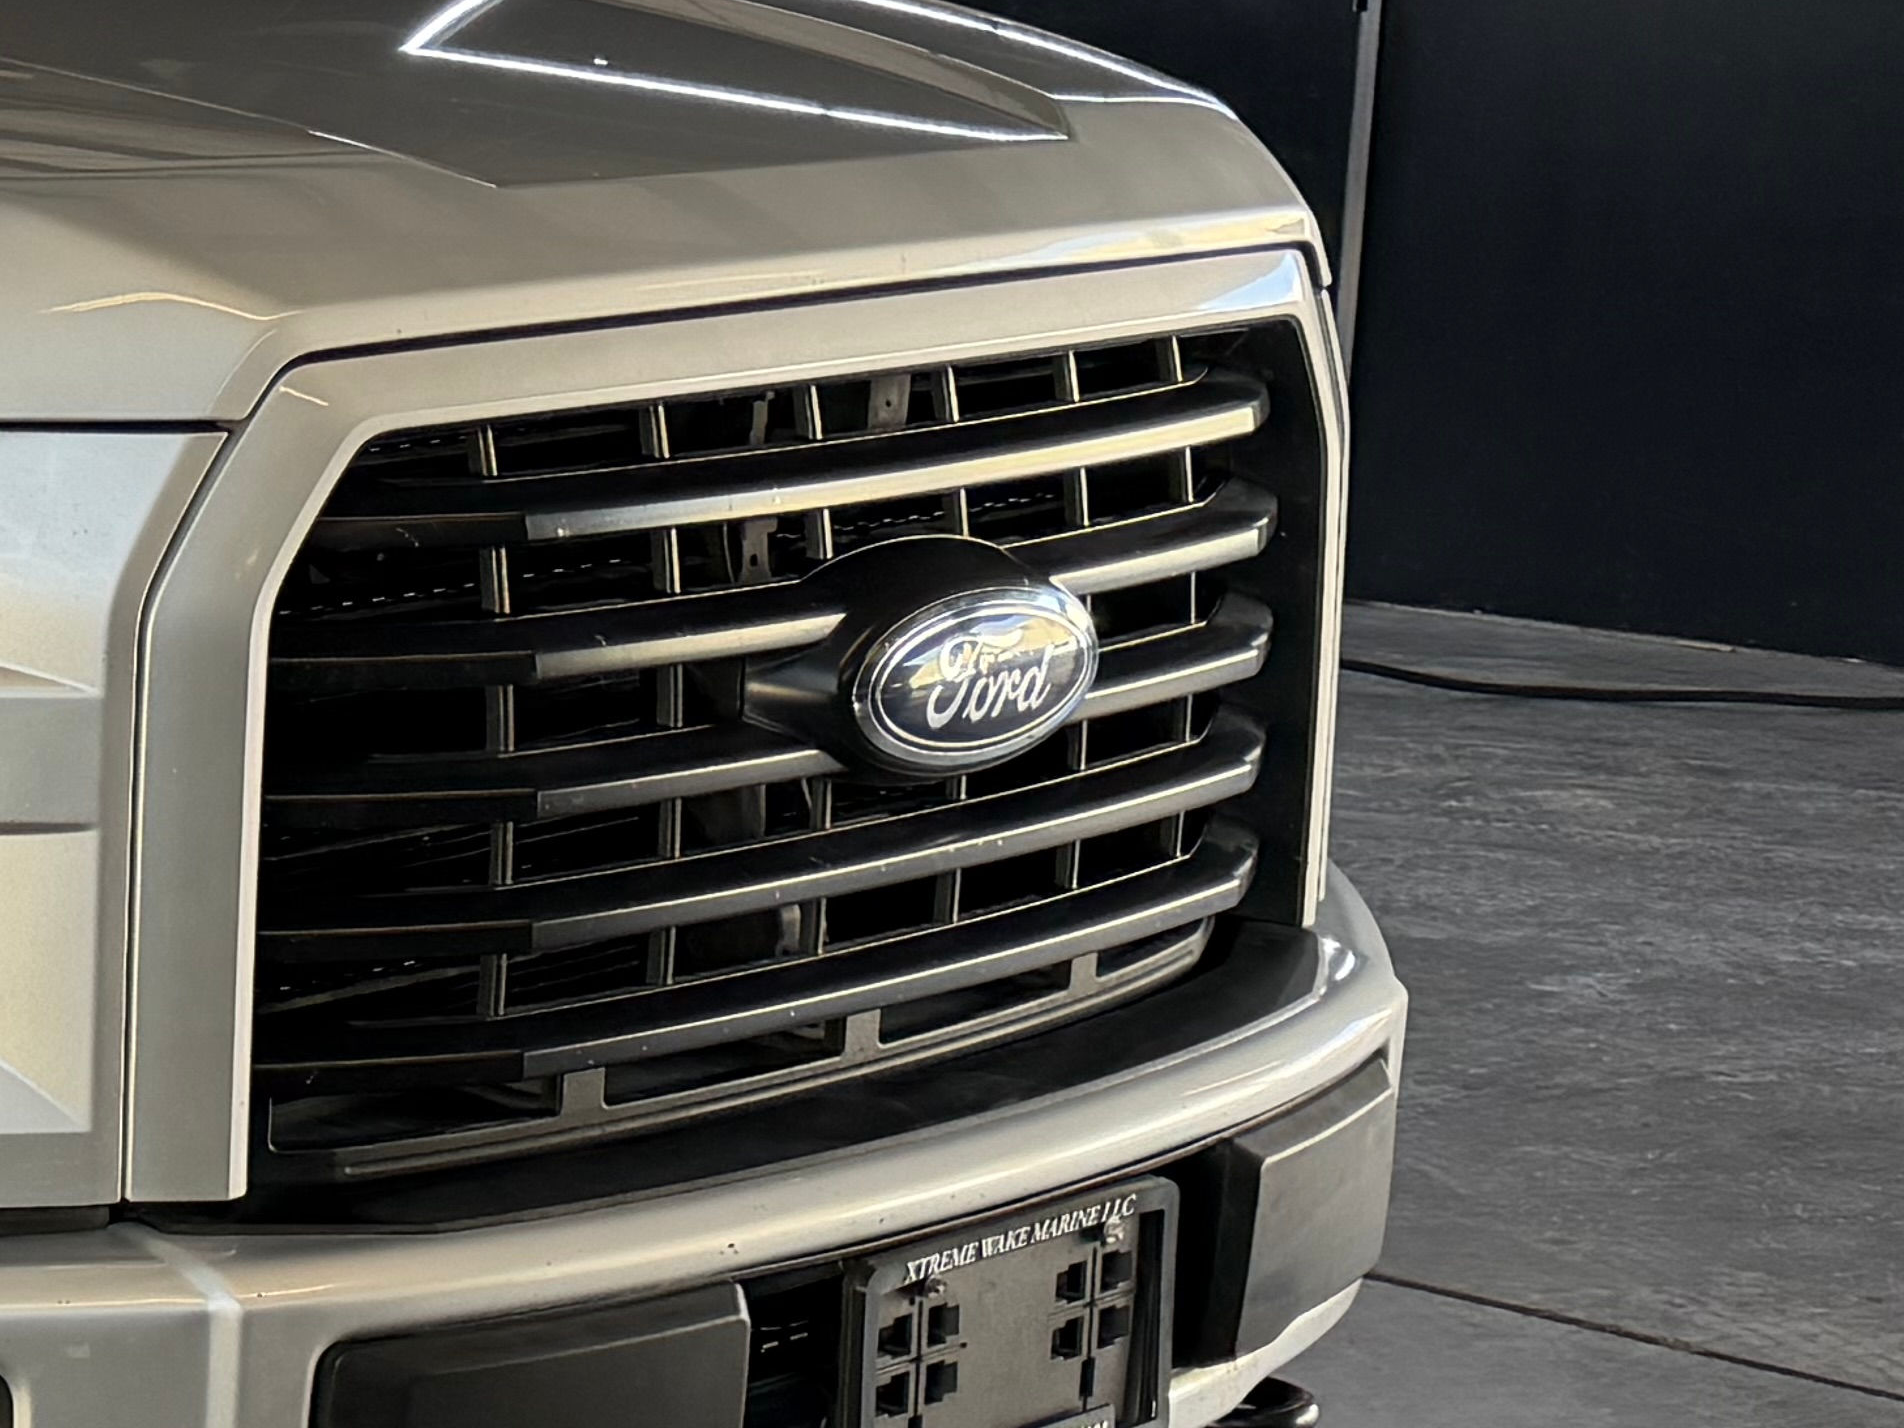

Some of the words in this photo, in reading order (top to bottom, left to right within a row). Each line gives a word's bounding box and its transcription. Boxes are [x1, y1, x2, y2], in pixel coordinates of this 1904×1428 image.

[926, 628, 1058, 730] Ford
[904, 1242, 979, 1285] XTREME
[981, 1226, 1031, 1258] WAKE
[1030, 1205, 1101, 1244] MARINE
